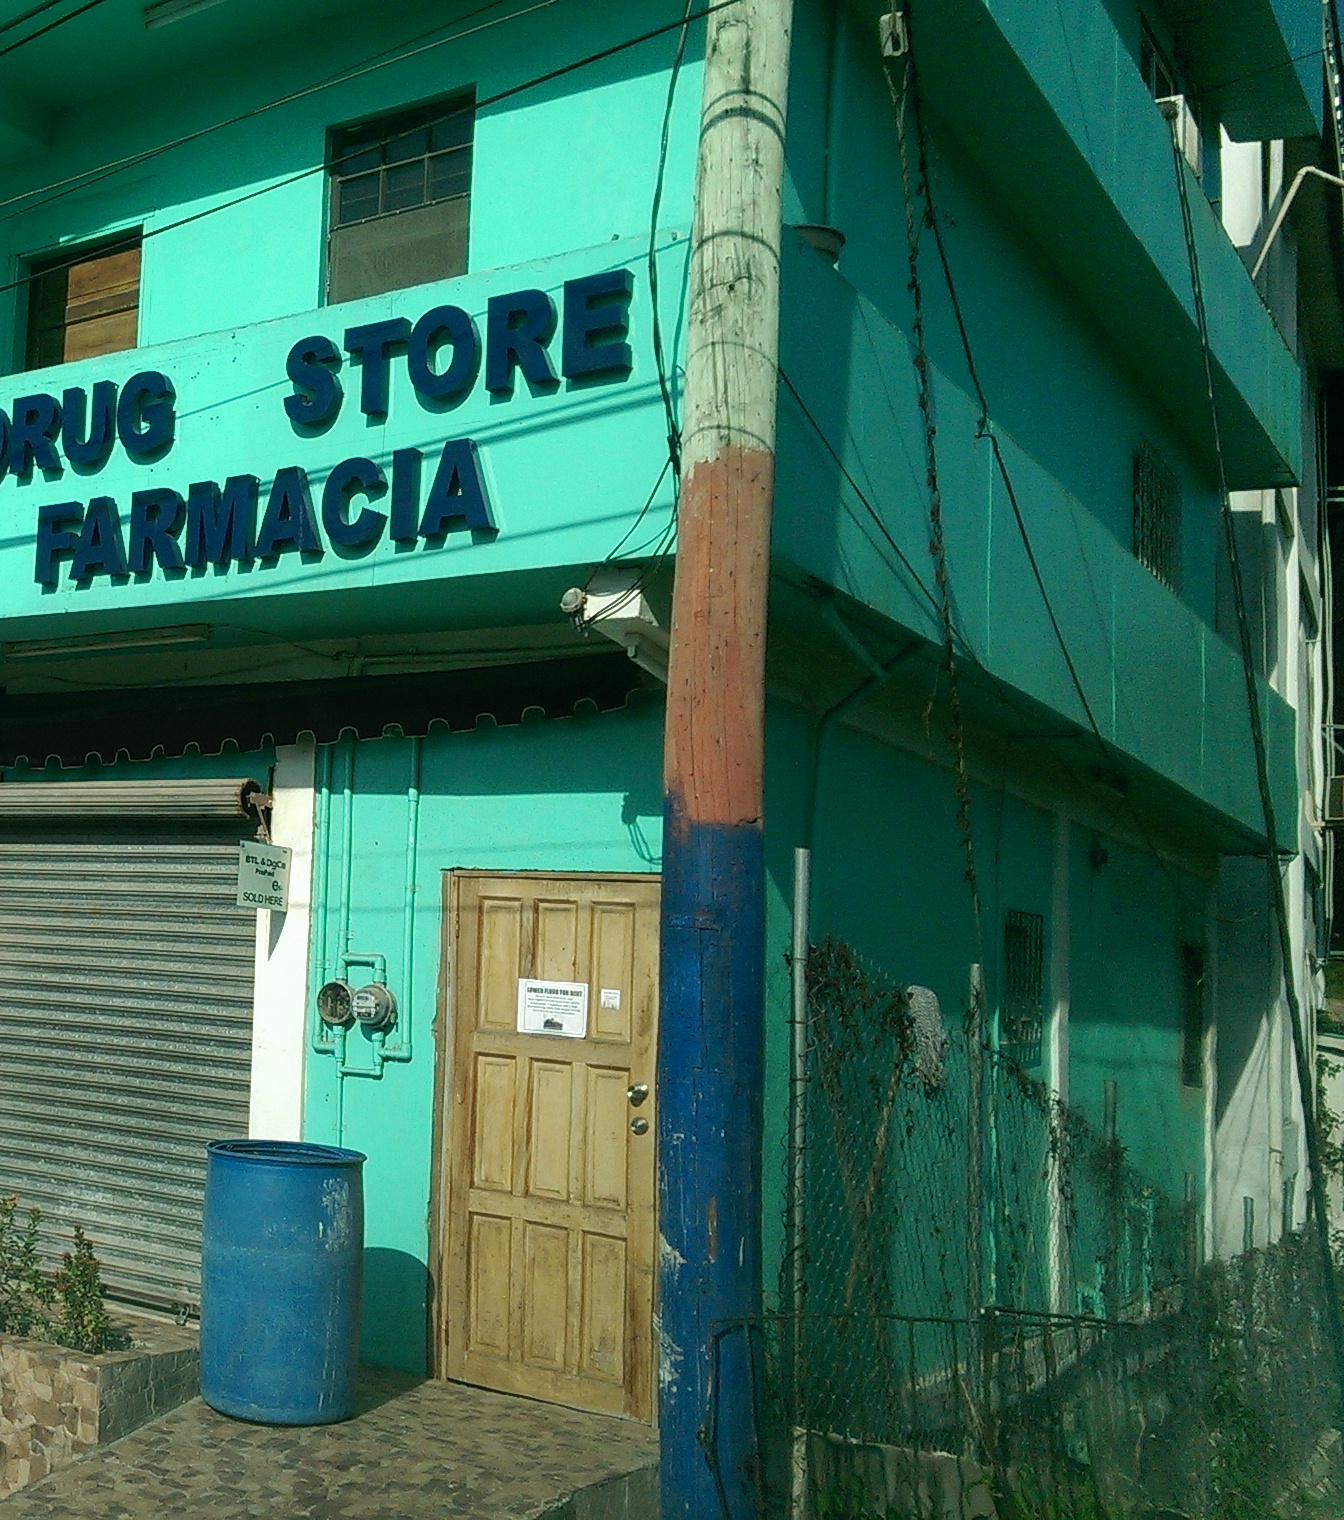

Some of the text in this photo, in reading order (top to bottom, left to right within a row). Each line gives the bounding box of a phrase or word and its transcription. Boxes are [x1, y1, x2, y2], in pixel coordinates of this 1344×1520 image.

[281, 267, 635, 429] STORE
[33, 436, 501, 586] FARMACIA
[243, 892, 283, 906] SOLD HERE
